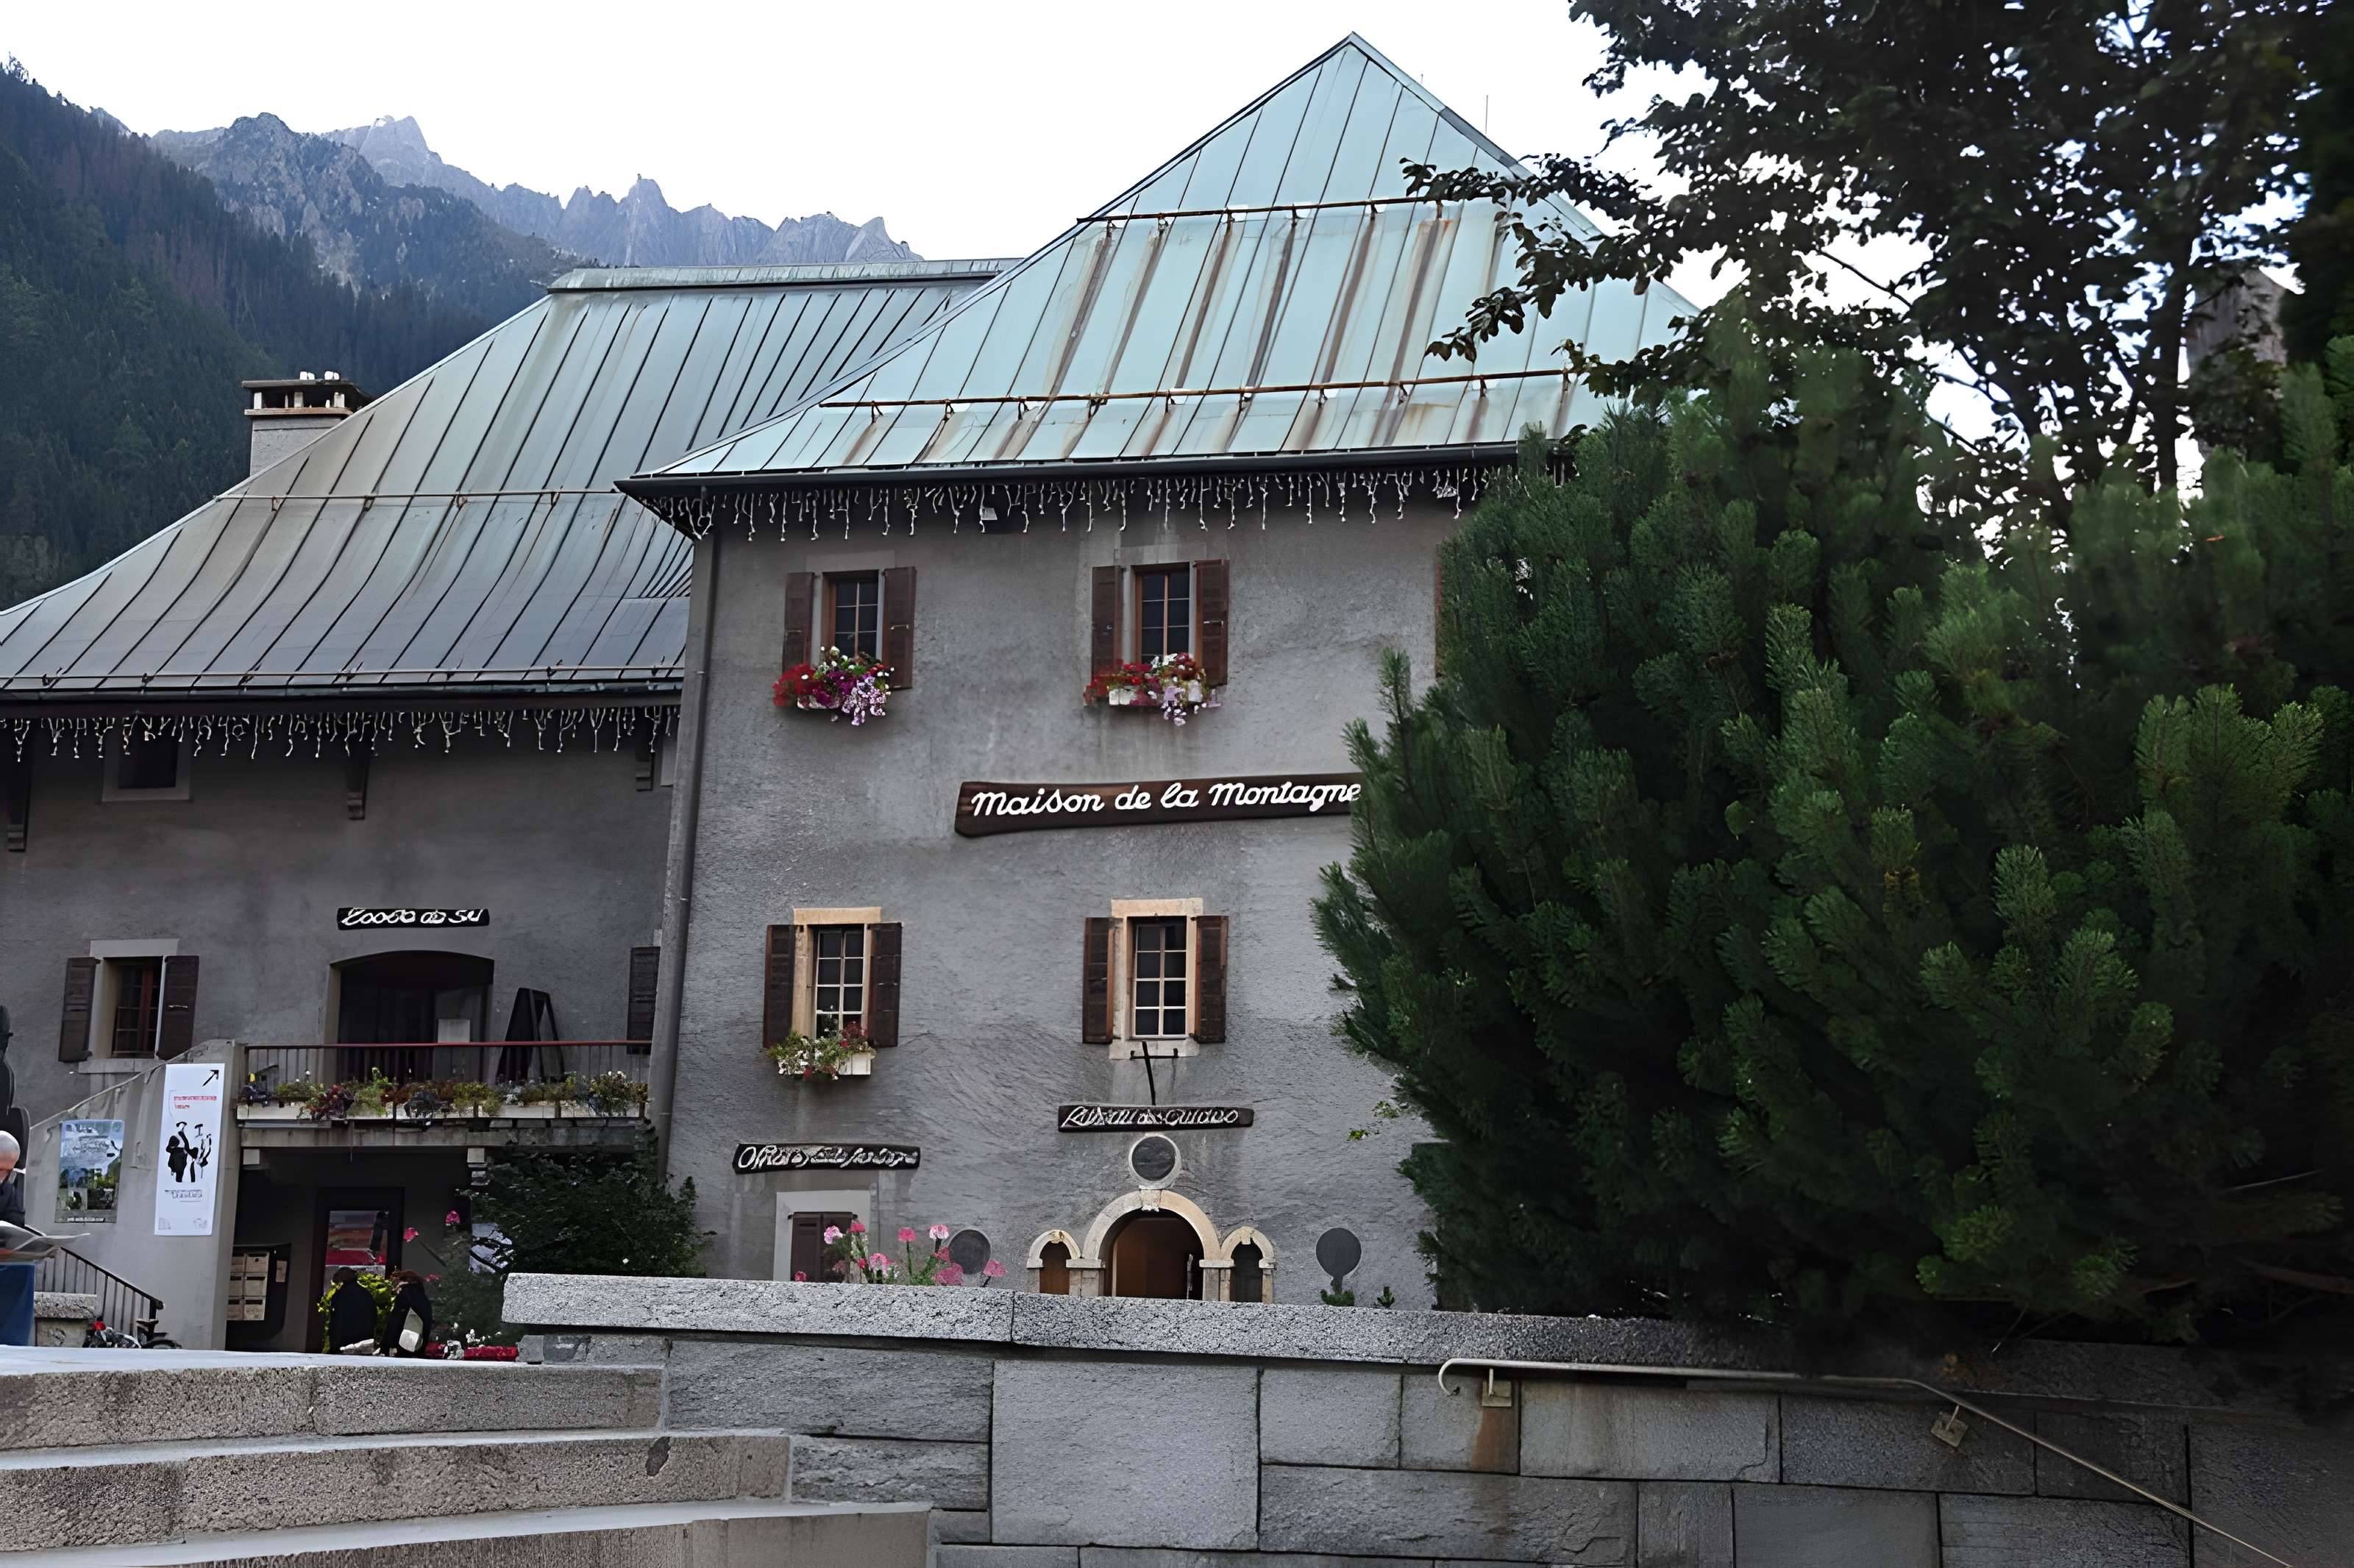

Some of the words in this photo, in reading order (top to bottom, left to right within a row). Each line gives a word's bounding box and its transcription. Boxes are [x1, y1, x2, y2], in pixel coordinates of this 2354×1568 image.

[970, 788, 1105, 816] Maison
[1114, 785, 1152, 810] de
[1160, 783, 1200, 808] la
[1208, 781, 1361, 812] Montagne
